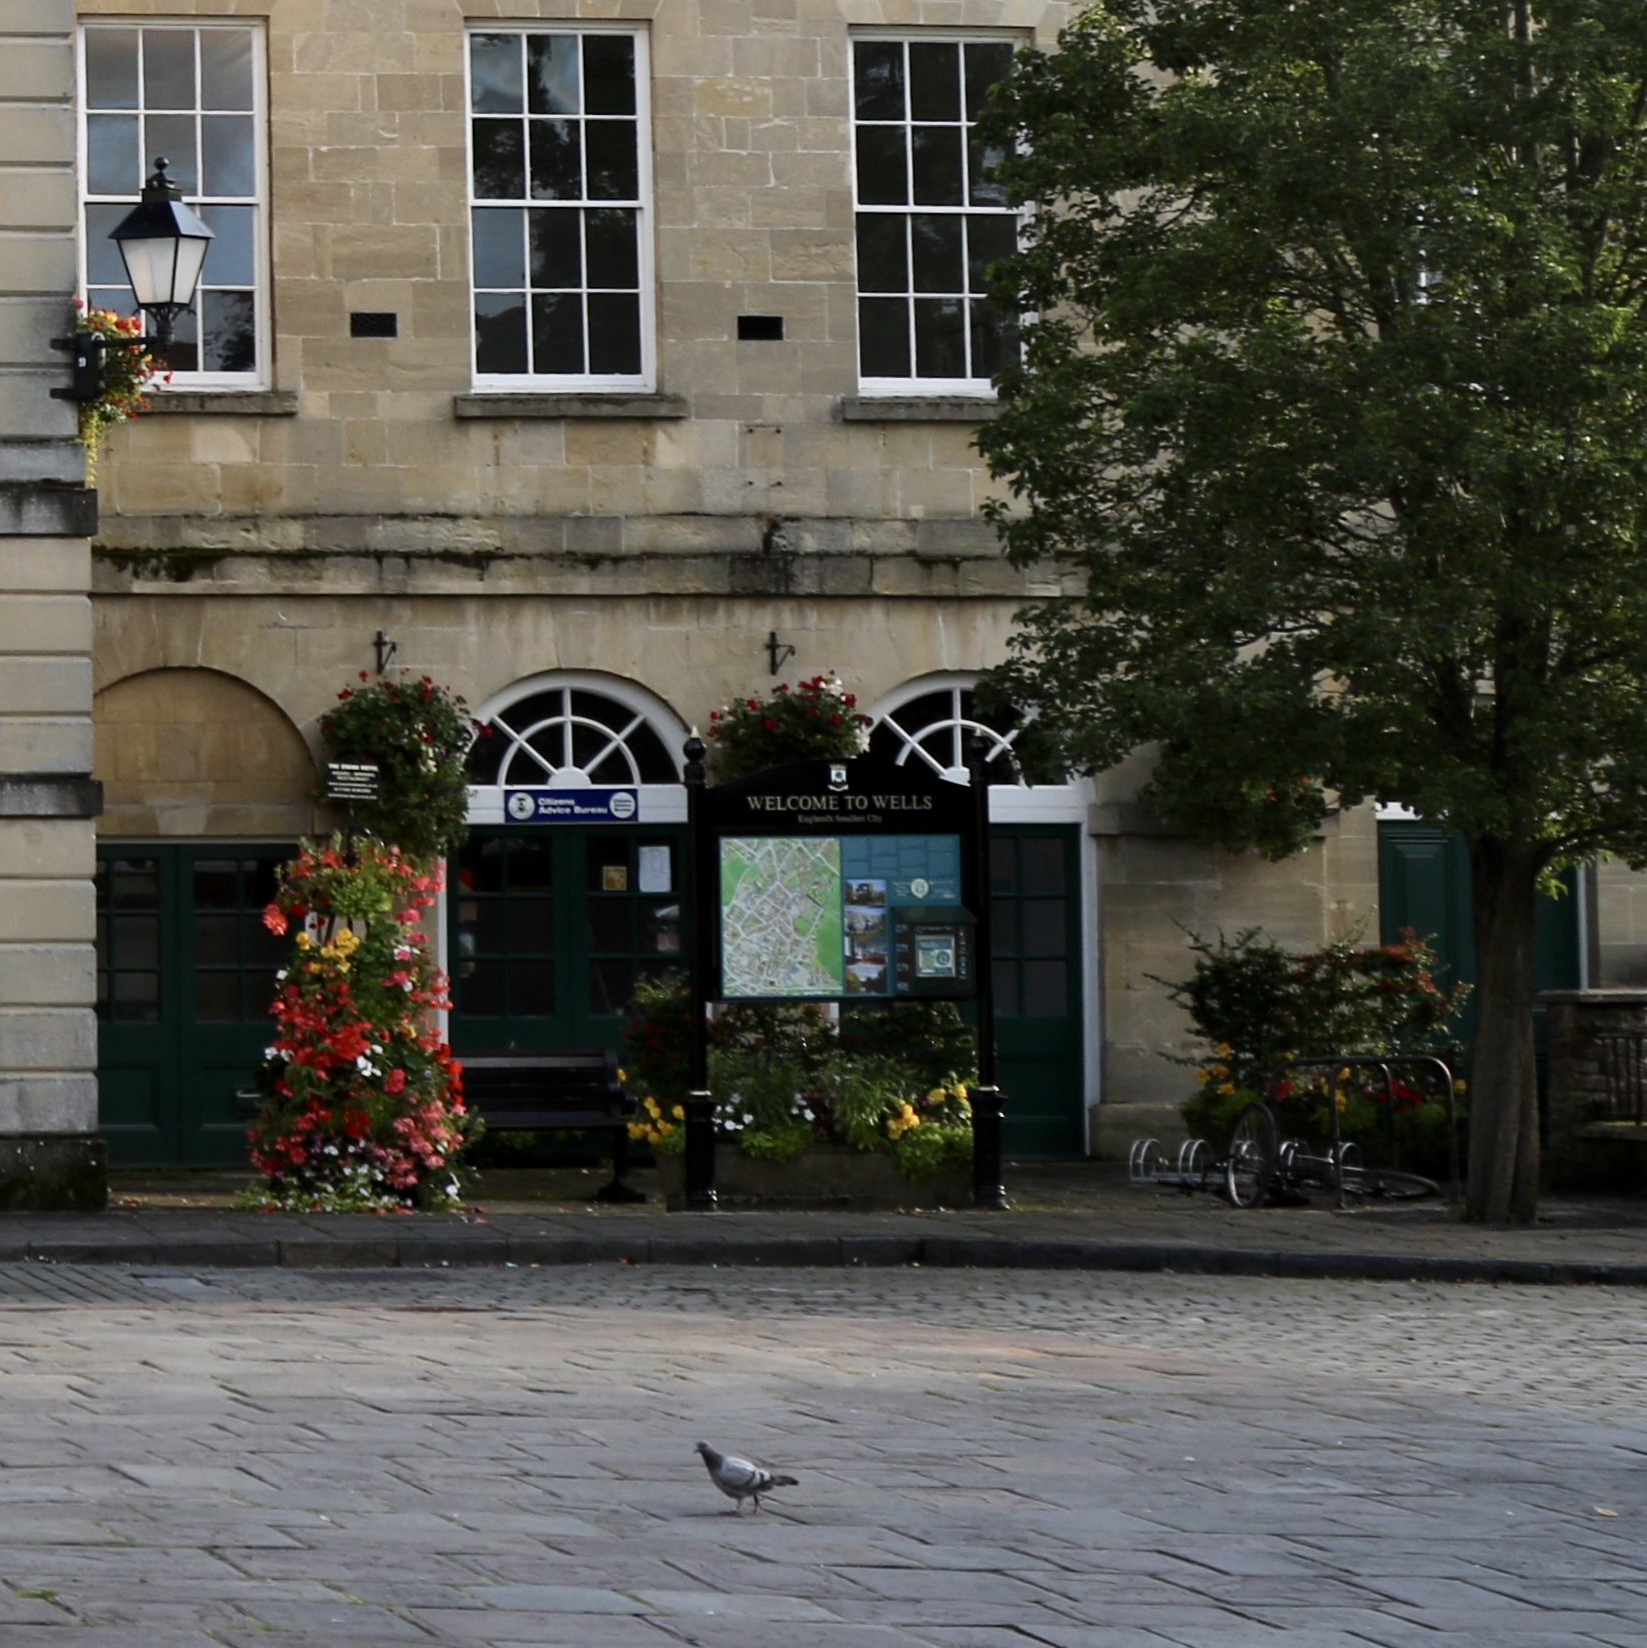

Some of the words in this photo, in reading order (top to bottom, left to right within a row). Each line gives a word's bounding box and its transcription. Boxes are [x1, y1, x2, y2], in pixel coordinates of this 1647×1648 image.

[538, 798, 575, 806] Citizens
[747, 796, 839, 810] WELCOME
[844, 796, 868, 810] TO
[873, 795, 933, 810] WELLS
[538, 806, 571, 815] Advice
[574, 806, 608, 815] Bureau
